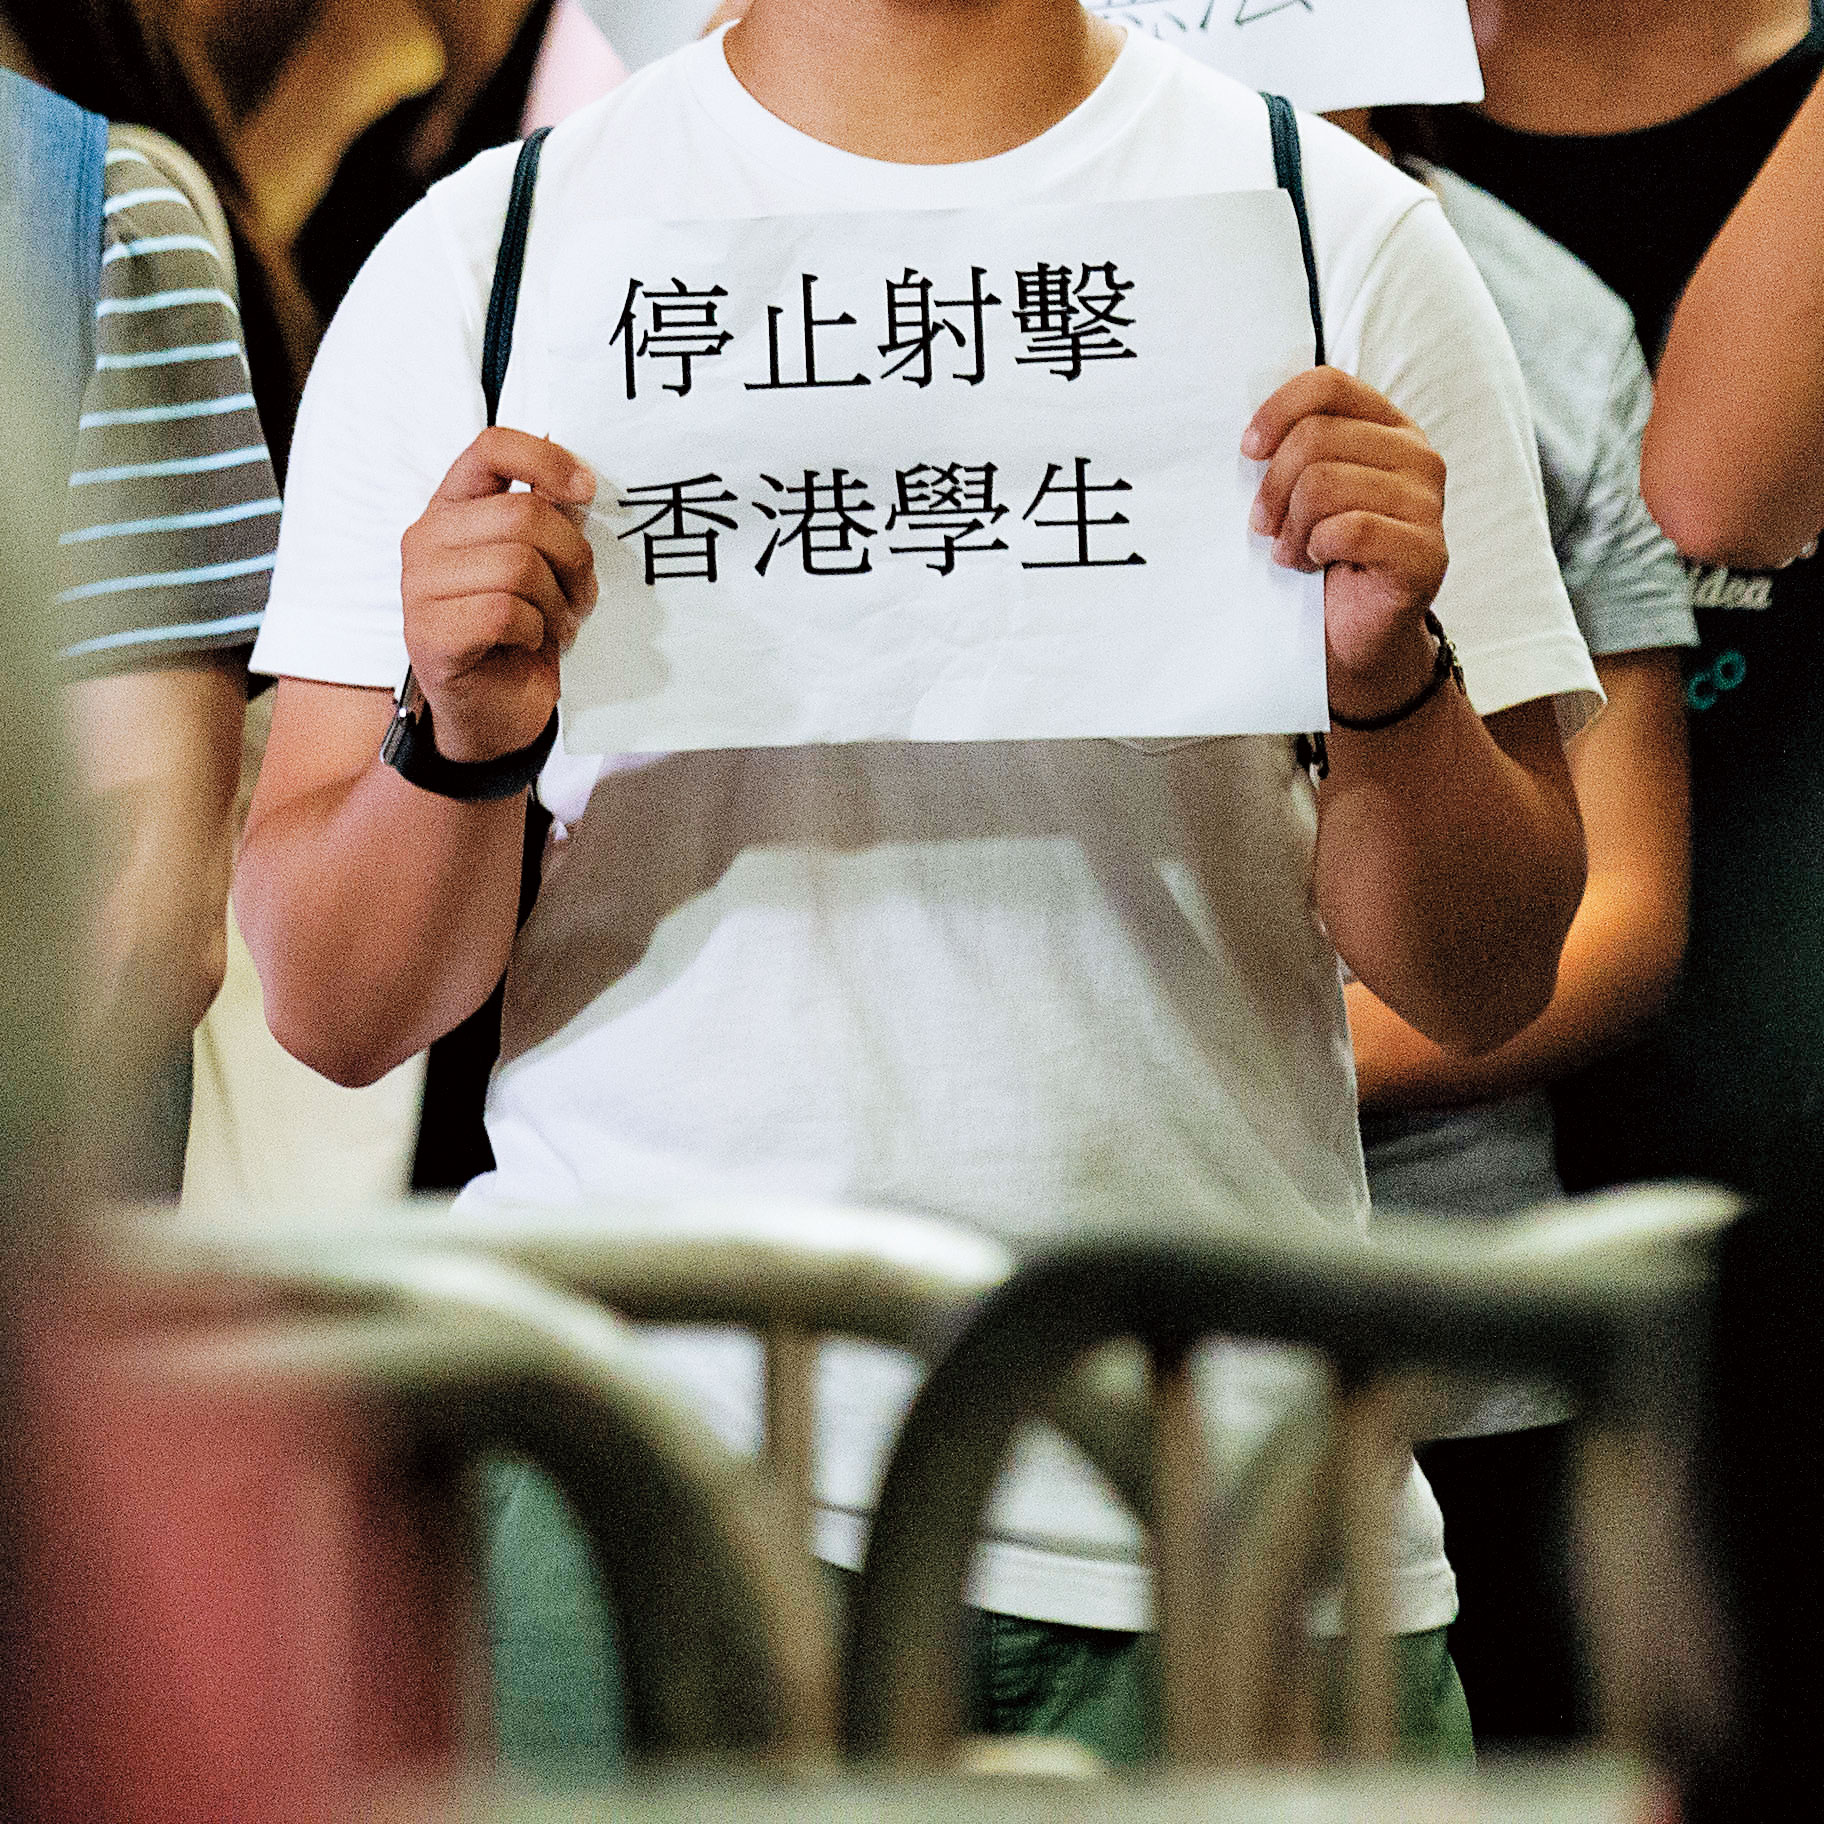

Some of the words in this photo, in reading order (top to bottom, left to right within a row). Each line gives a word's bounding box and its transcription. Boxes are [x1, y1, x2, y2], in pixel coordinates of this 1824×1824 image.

[607, 259, 1139, 401] 停止射擊
[615, 455, 1147, 587] 香港學生
